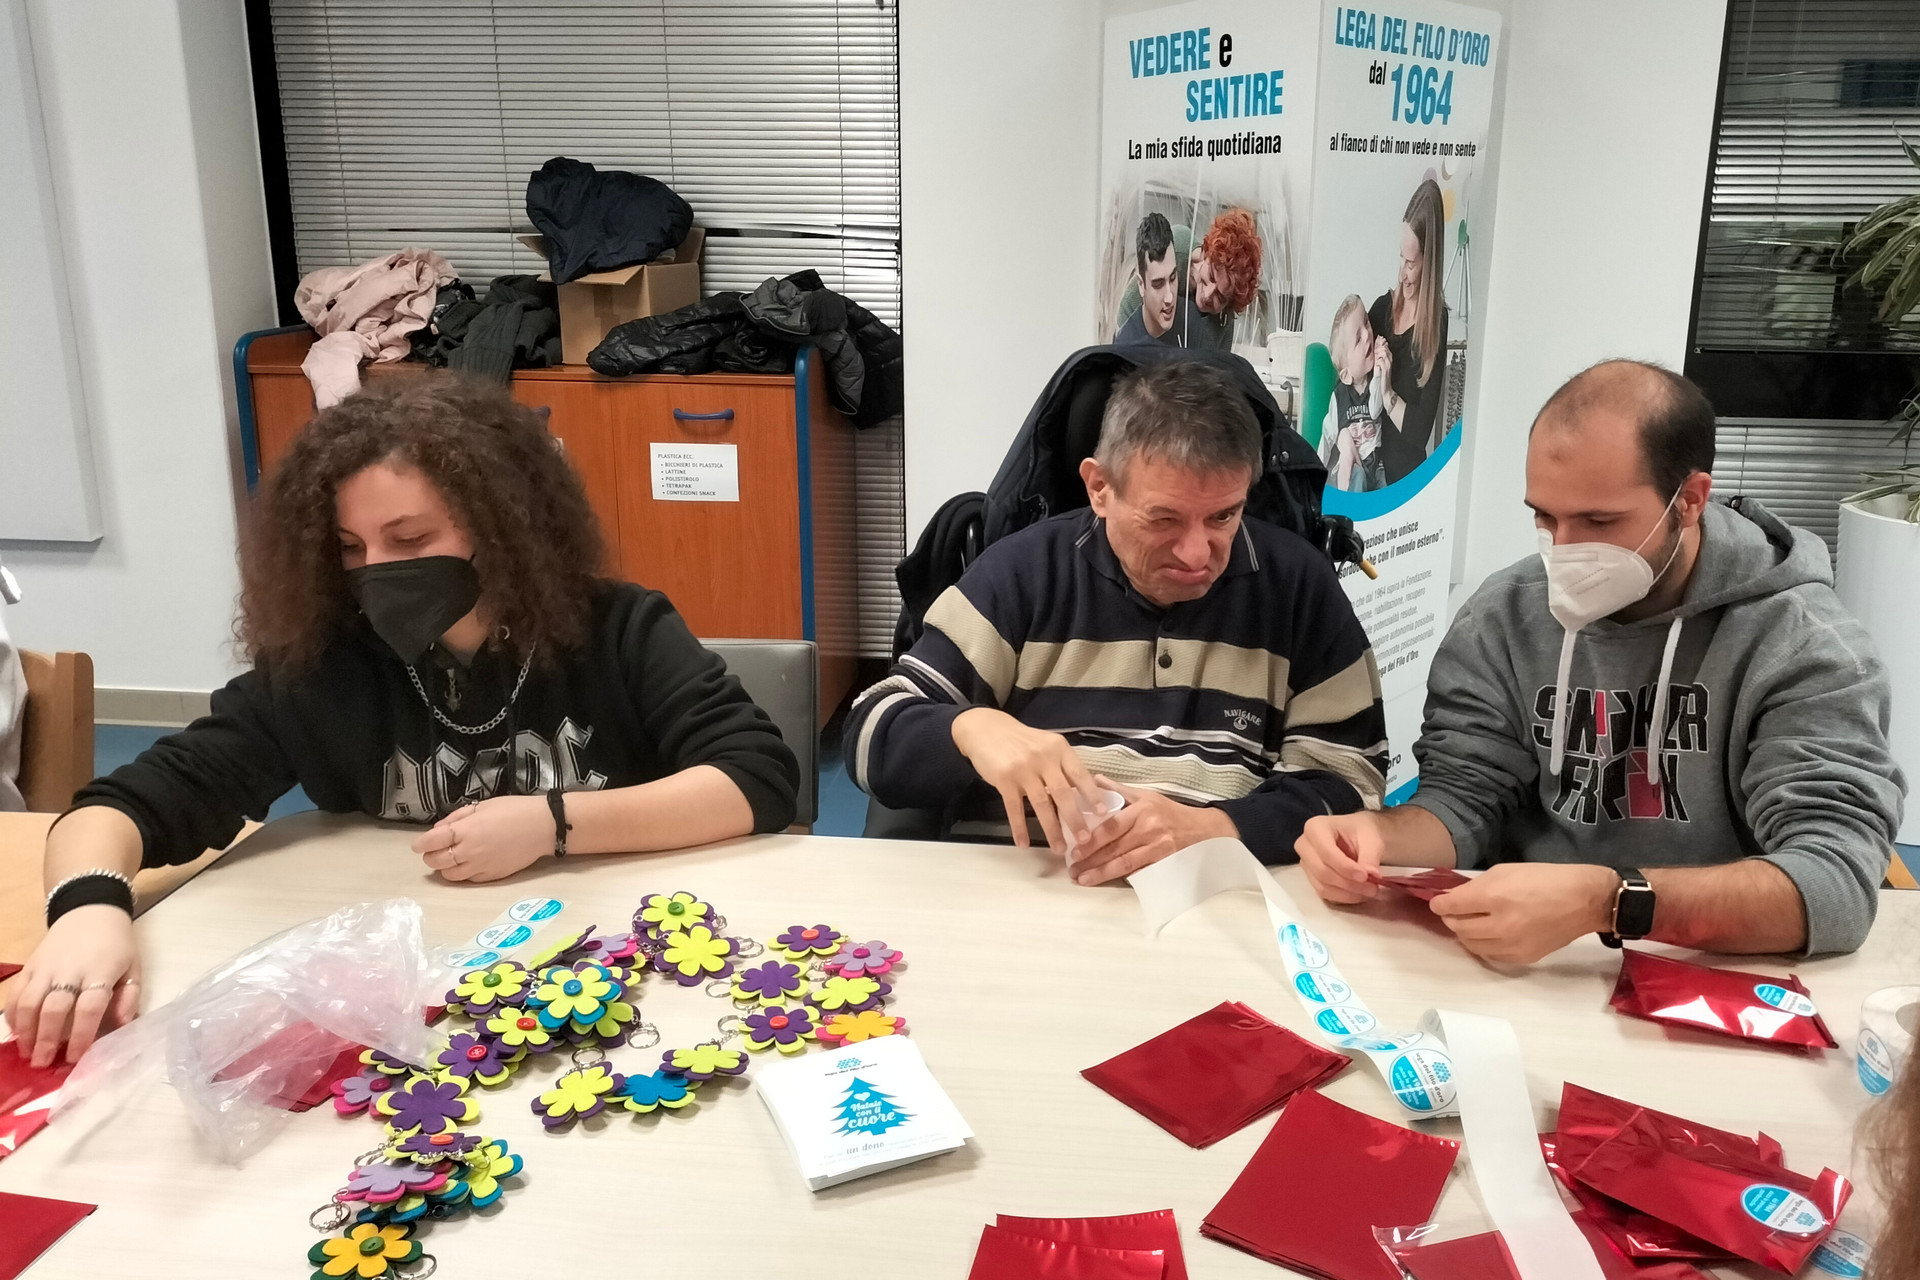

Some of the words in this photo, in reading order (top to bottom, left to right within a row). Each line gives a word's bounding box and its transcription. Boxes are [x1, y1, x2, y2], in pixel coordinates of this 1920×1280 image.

[1335, 6, 1376, 50] LEGA
[1380, 15, 1408, 55] DEL
[1412, 22, 1446, 61] FILO
[1447, 28, 1490, 67] D'ORO
[1129, 27, 1211, 79] VEDERE
[1219, 33, 1232, 68] e
[1186, 69, 1284, 123] SENTIRE
[1369, 60, 1387, 85] dal
[1391, 63, 1454, 125] 1964
[1128, 139, 1142, 160] La
[1145, 138, 1168, 159] mia
[1171, 136, 1203, 158] sfida
[1207, 131, 1282, 161] quotidiana
[1330, 132, 1339, 151] al
[1341, 133, 1368, 153] fianco
[1370, 135, 1378, 153] di
[1380, 136, 1394, 155] chi
[1395, 140, 1410, 155] non
[1412, 138, 1431, 156] vede
[1432, 143, 1438, 156] e
[1439, 142, 1453, 157] non
[1455, 141, 1476, 158] sente
[1363, 532, 1385, 549] rezioso
[1386, 527, 1398, 542] che
[1398, 521, 1419, 537] unisce
[1378, 550, 1389, 563] con
[1390, 545, 1396, 559] il
[1396, 539, 1416, 557] mondo
[1379, 666, 1387, 678] ega
[1223, 709, 1262, 726] NAVIGARE
[850, 1100, 883, 1112] Natale
[855, 1109, 872, 1117] con
[874, 1106, 881, 1114] il
[847, 1111, 897, 1129] cuore
[862, 1142, 885, 1151] dono
